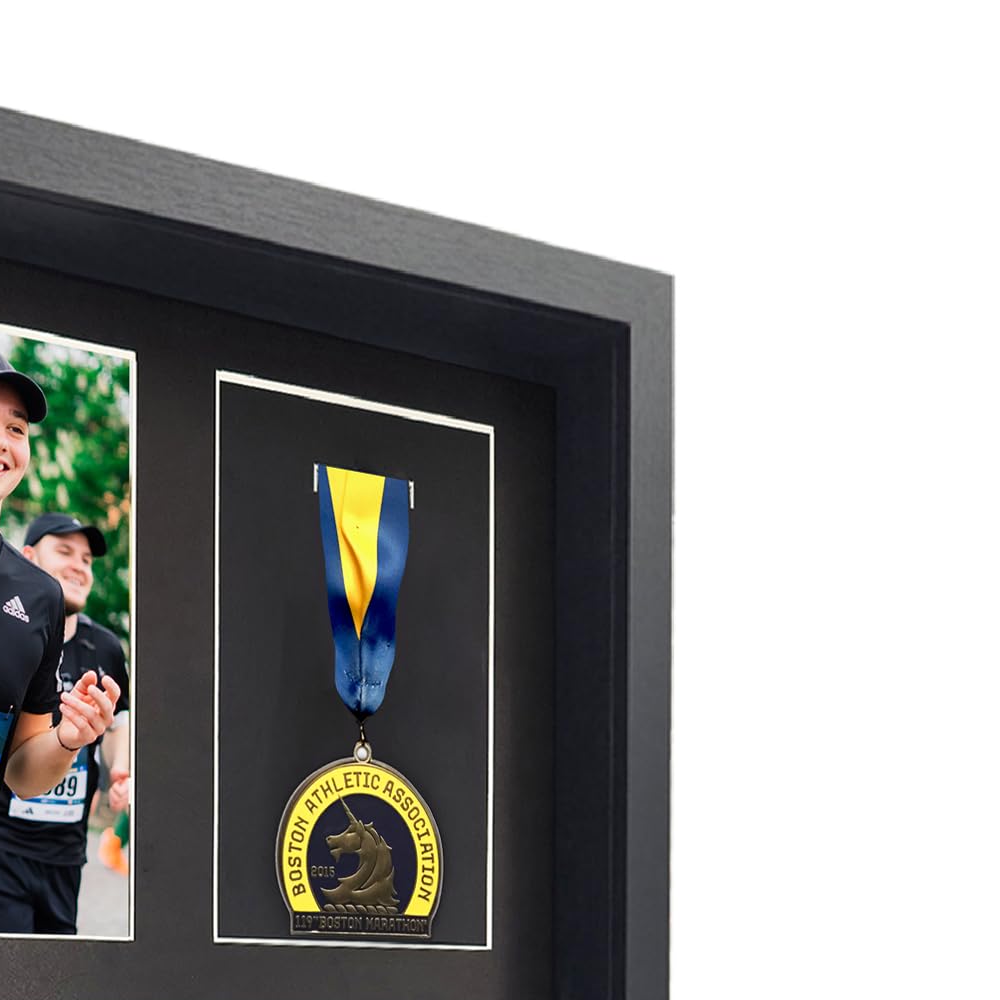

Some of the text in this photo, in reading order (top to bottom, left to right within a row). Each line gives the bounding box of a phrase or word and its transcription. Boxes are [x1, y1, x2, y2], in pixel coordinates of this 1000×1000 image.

[288, 772, 435, 902] BOSTON ATHLETIC ASSOCIATION
[311, 865, 335, 878] 2015
[320, 915, 362, 929] BOSTON
